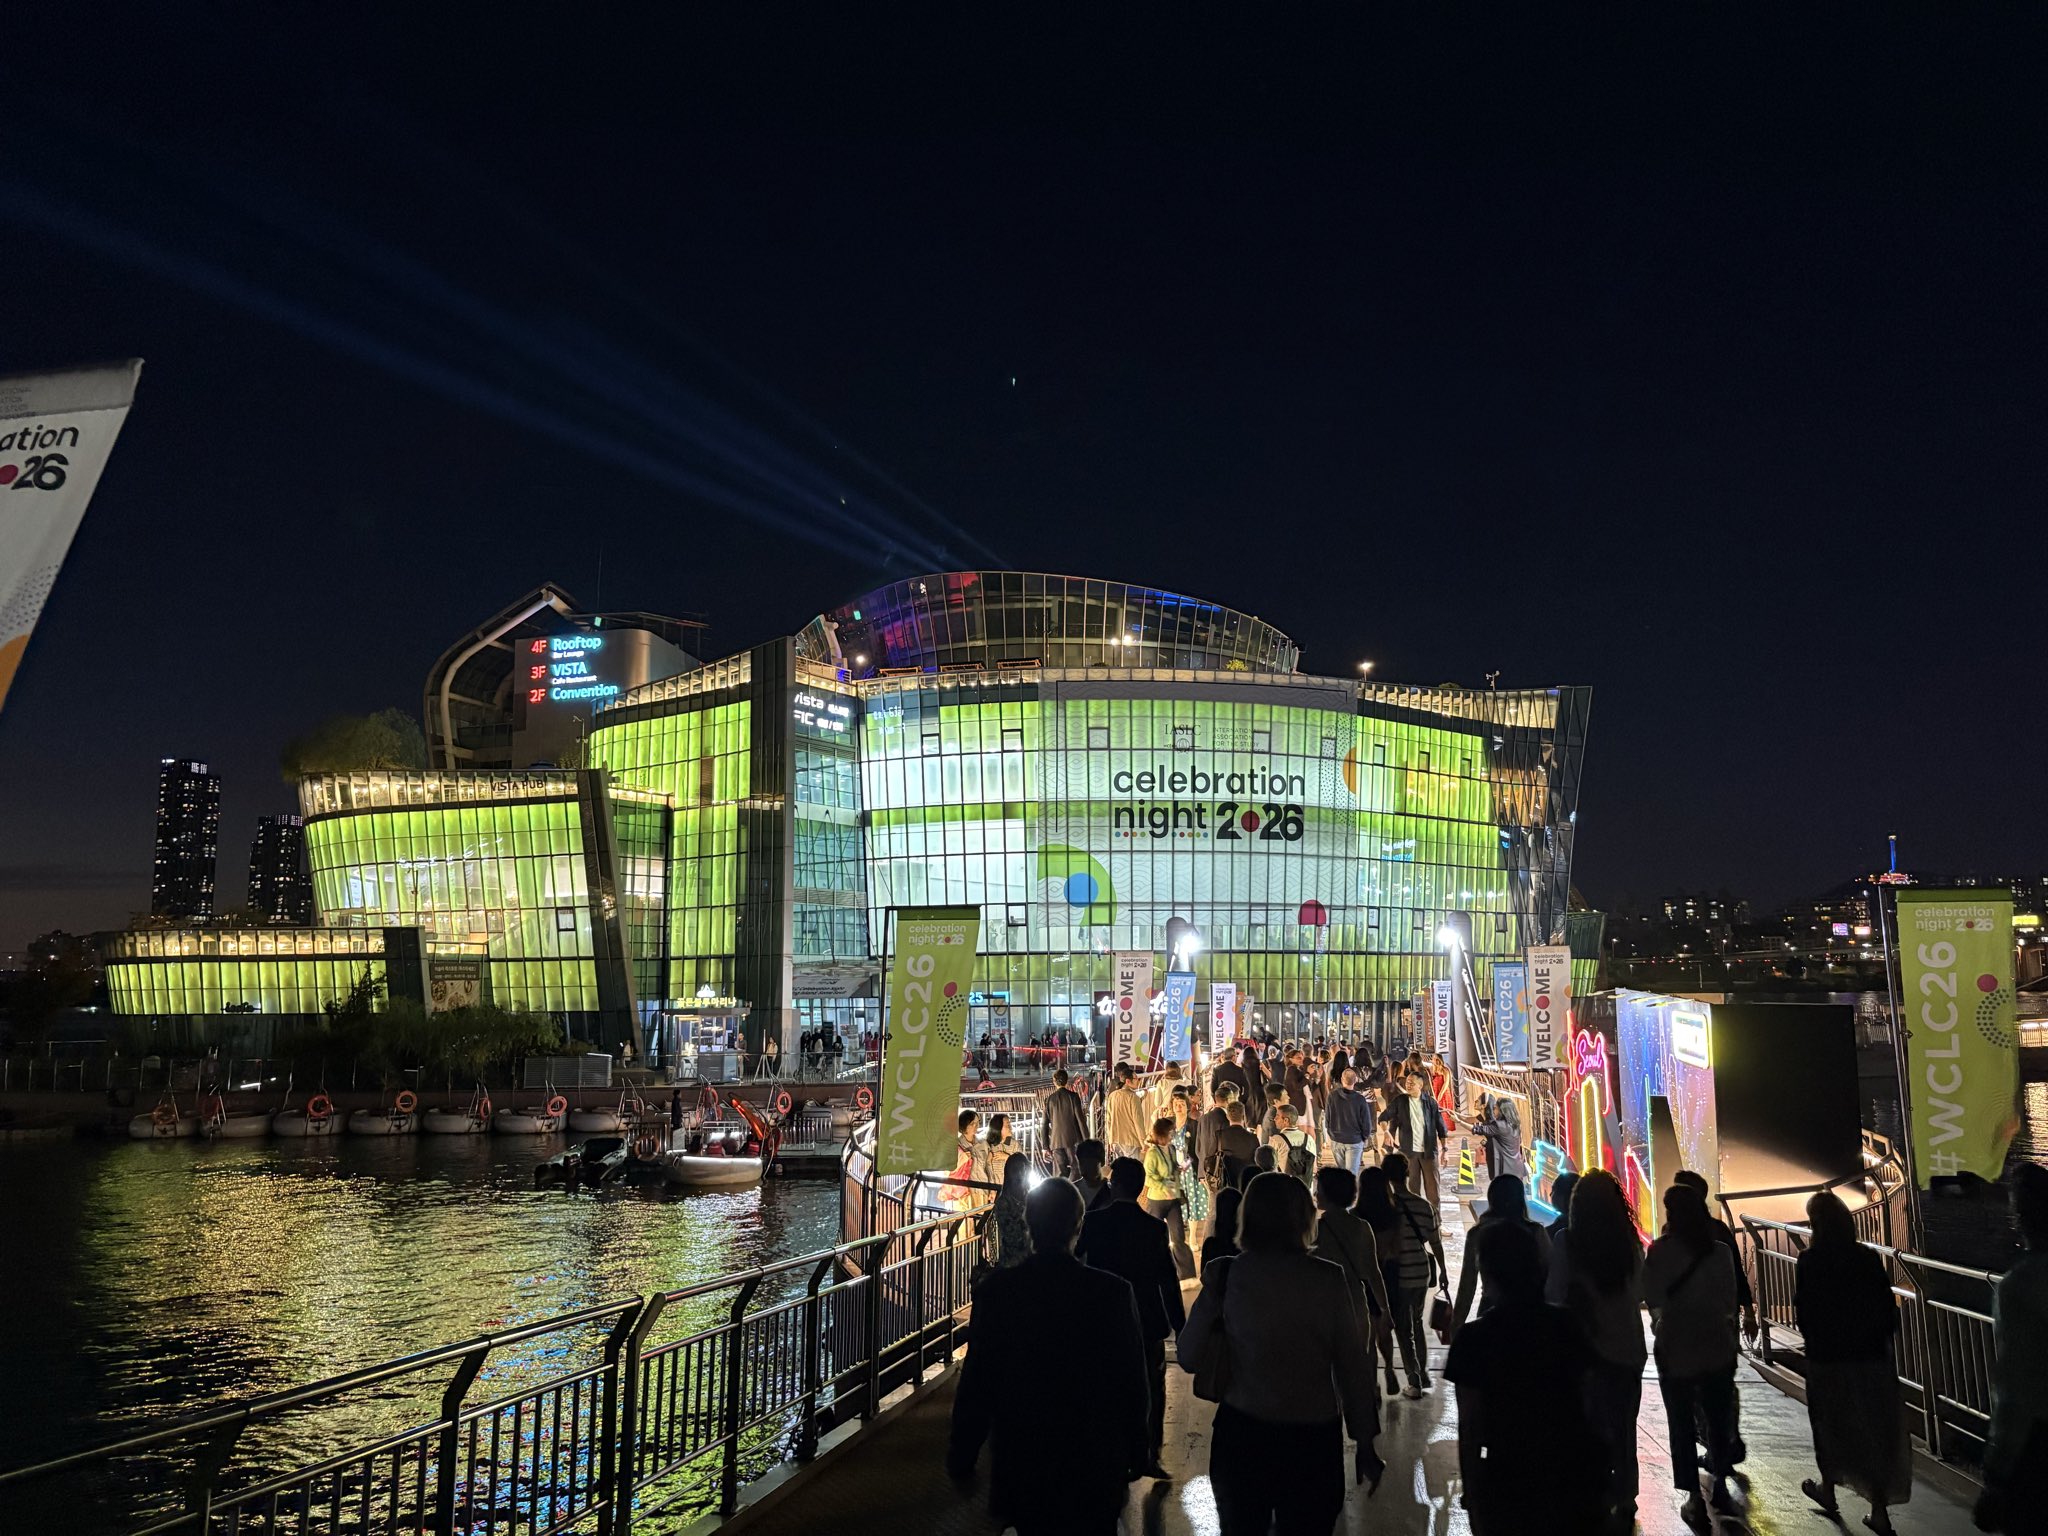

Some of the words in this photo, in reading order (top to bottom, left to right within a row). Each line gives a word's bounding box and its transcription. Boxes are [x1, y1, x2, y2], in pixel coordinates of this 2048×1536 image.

[531, 640, 547, 653] 4F
[553, 636, 602, 651] Rooftop
[531, 665, 546, 679] 3F
[553, 662, 587, 676] VISTA
[530, 689, 546, 702] 2F
[553, 684, 618, 700] Convention
[1165, 724, 1201, 735] IASLC
[491, 781, 519, 791] VISTA
[521, 780, 544, 790] PUB
[1113, 764, 1305, 796] celebration
[1114, 799, 1207, 838] night
[909, 923, 967, 933] celebration
[1914, 907, 1994, 917] celebration
[1916, 919, 1952, 931] night
[908, 934, 935, 945] night
[1118, 971, 1134, 1061] WELCOME
[1168, 987, 1182, 1058] #WCLC26
[1216, 995, 1225, 1050] WELCOME
[1438, 994, 1448, 1049] WELCOME
[1500, 980, 1513, 1058] #WCLC26
[1535, 968, 1551, 1063] WELCOME
[888, 954, 935, 1166] #WCLC26
[1578, 1039, 1604, 1075] Seoul
[1918, 941, 1964, 1176] #WCLC26
